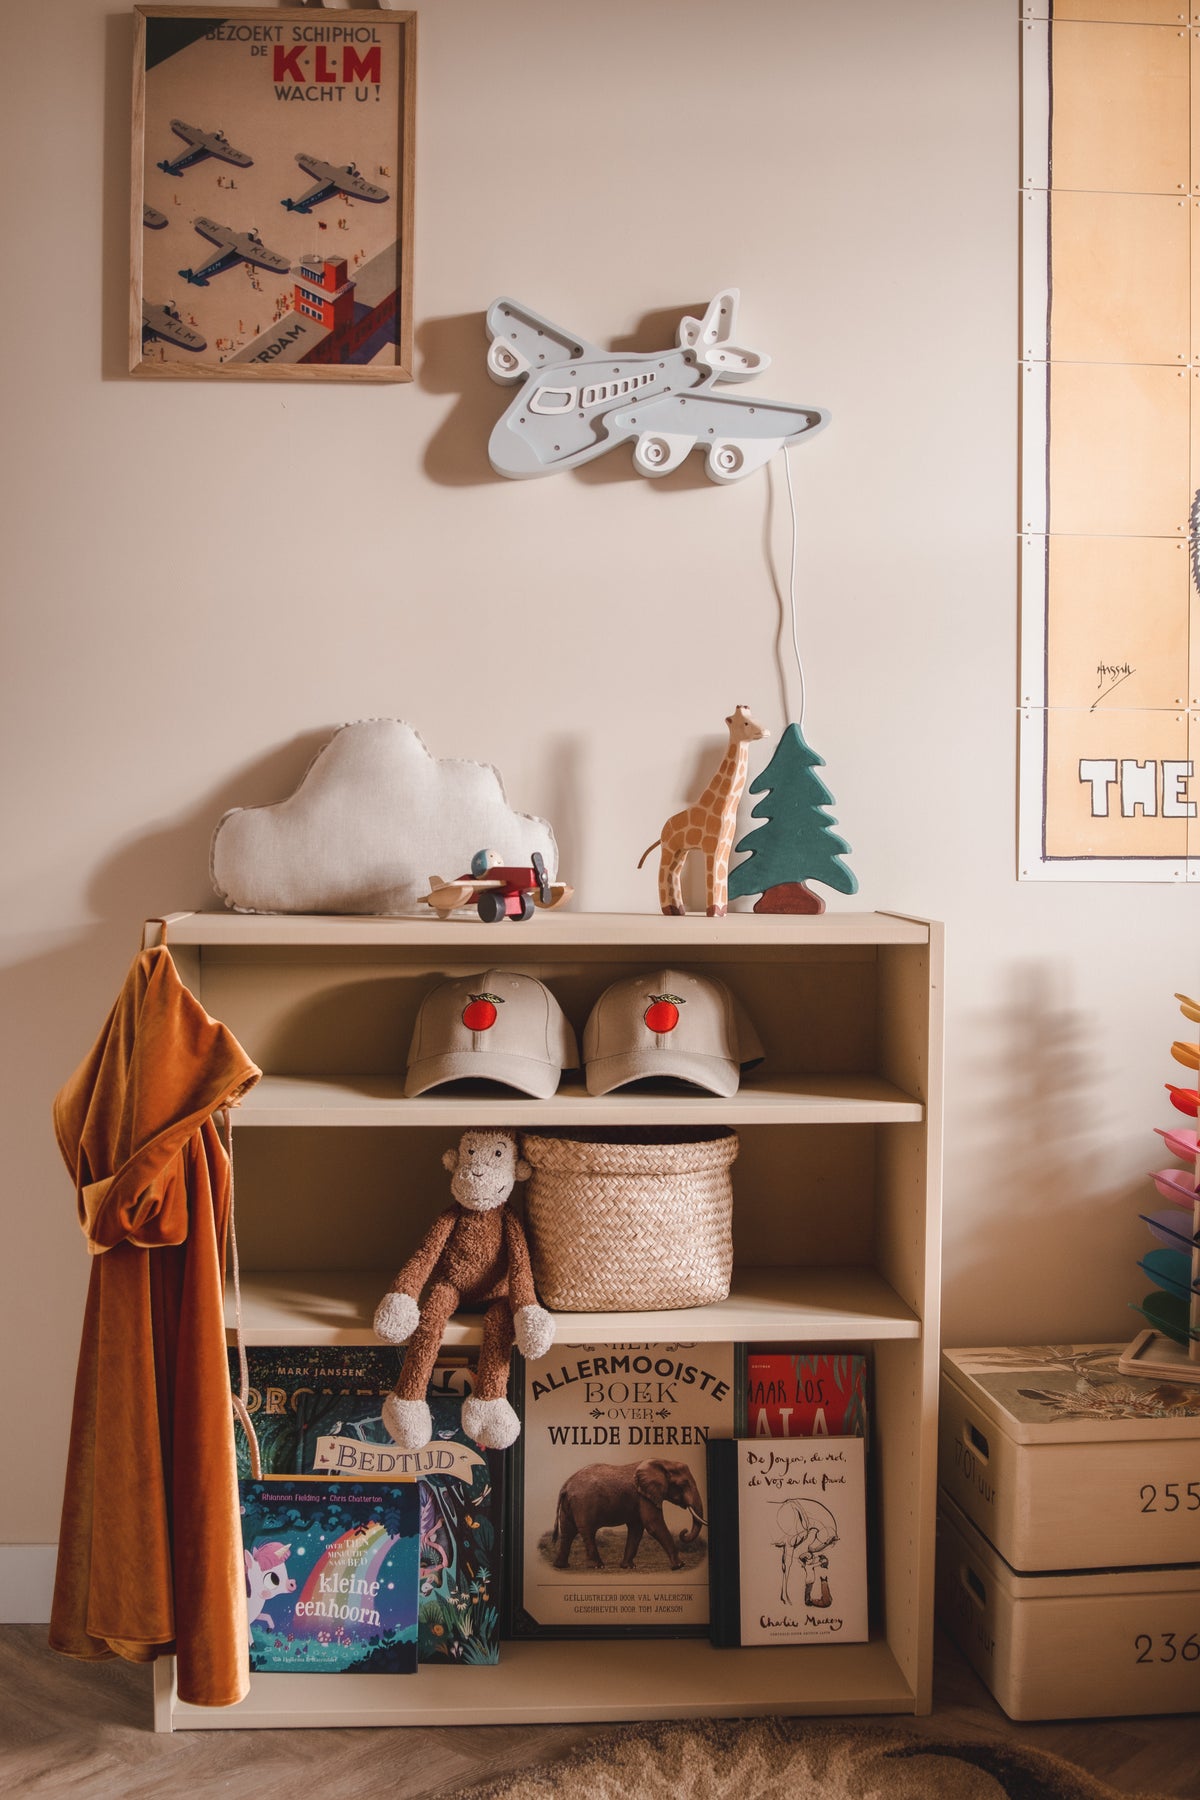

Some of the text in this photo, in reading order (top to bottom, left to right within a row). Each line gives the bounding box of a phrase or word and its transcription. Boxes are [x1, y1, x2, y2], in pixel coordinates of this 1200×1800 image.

[206, 25, 381, 43] BEZOEKT SCHIPHOL
[250, 45, 268, 57] DE
[274, 86, 345, 102] WACHT
[352, 179, 378, 195] KLM
[250, 246, 282, 265] KLM
[164, 320, 197, 343] KLM
[1078, 758, 1198, 819] THE
[277, 1367, 364, 1377] MARK JANSSEN
[531, 1355, 731, 1401] ALLERMOOISTE
[584, 1382, 679, 1403] BOEK
[606, 1407, 653, 1422] OVER
[547, 1426, 710, 1445] WILDE DIEREN
[336, 1444, 455, 1472] BEDTIJD
[748, 1451, 765, 1465] De
[329, 1494, 347, 1502] Chris
[348, 1494, 383, 1503] Chatterton
[977, 1474, 997, 1506] uur
[1140, 1482, 1200, 1513] 255
[319, 1572, 380, 1597] kleine
[295, 1599, 381, 1627] eenhoorn
[621, 1605, 635, 1613] DOOR
[639, 1605, 652, 1613] TOM
[655, 1605, 683, 1613] JACKSON
[760, 1615, 799, 1628] Charlie
[1134, 1633, 1200, 1664] 236
